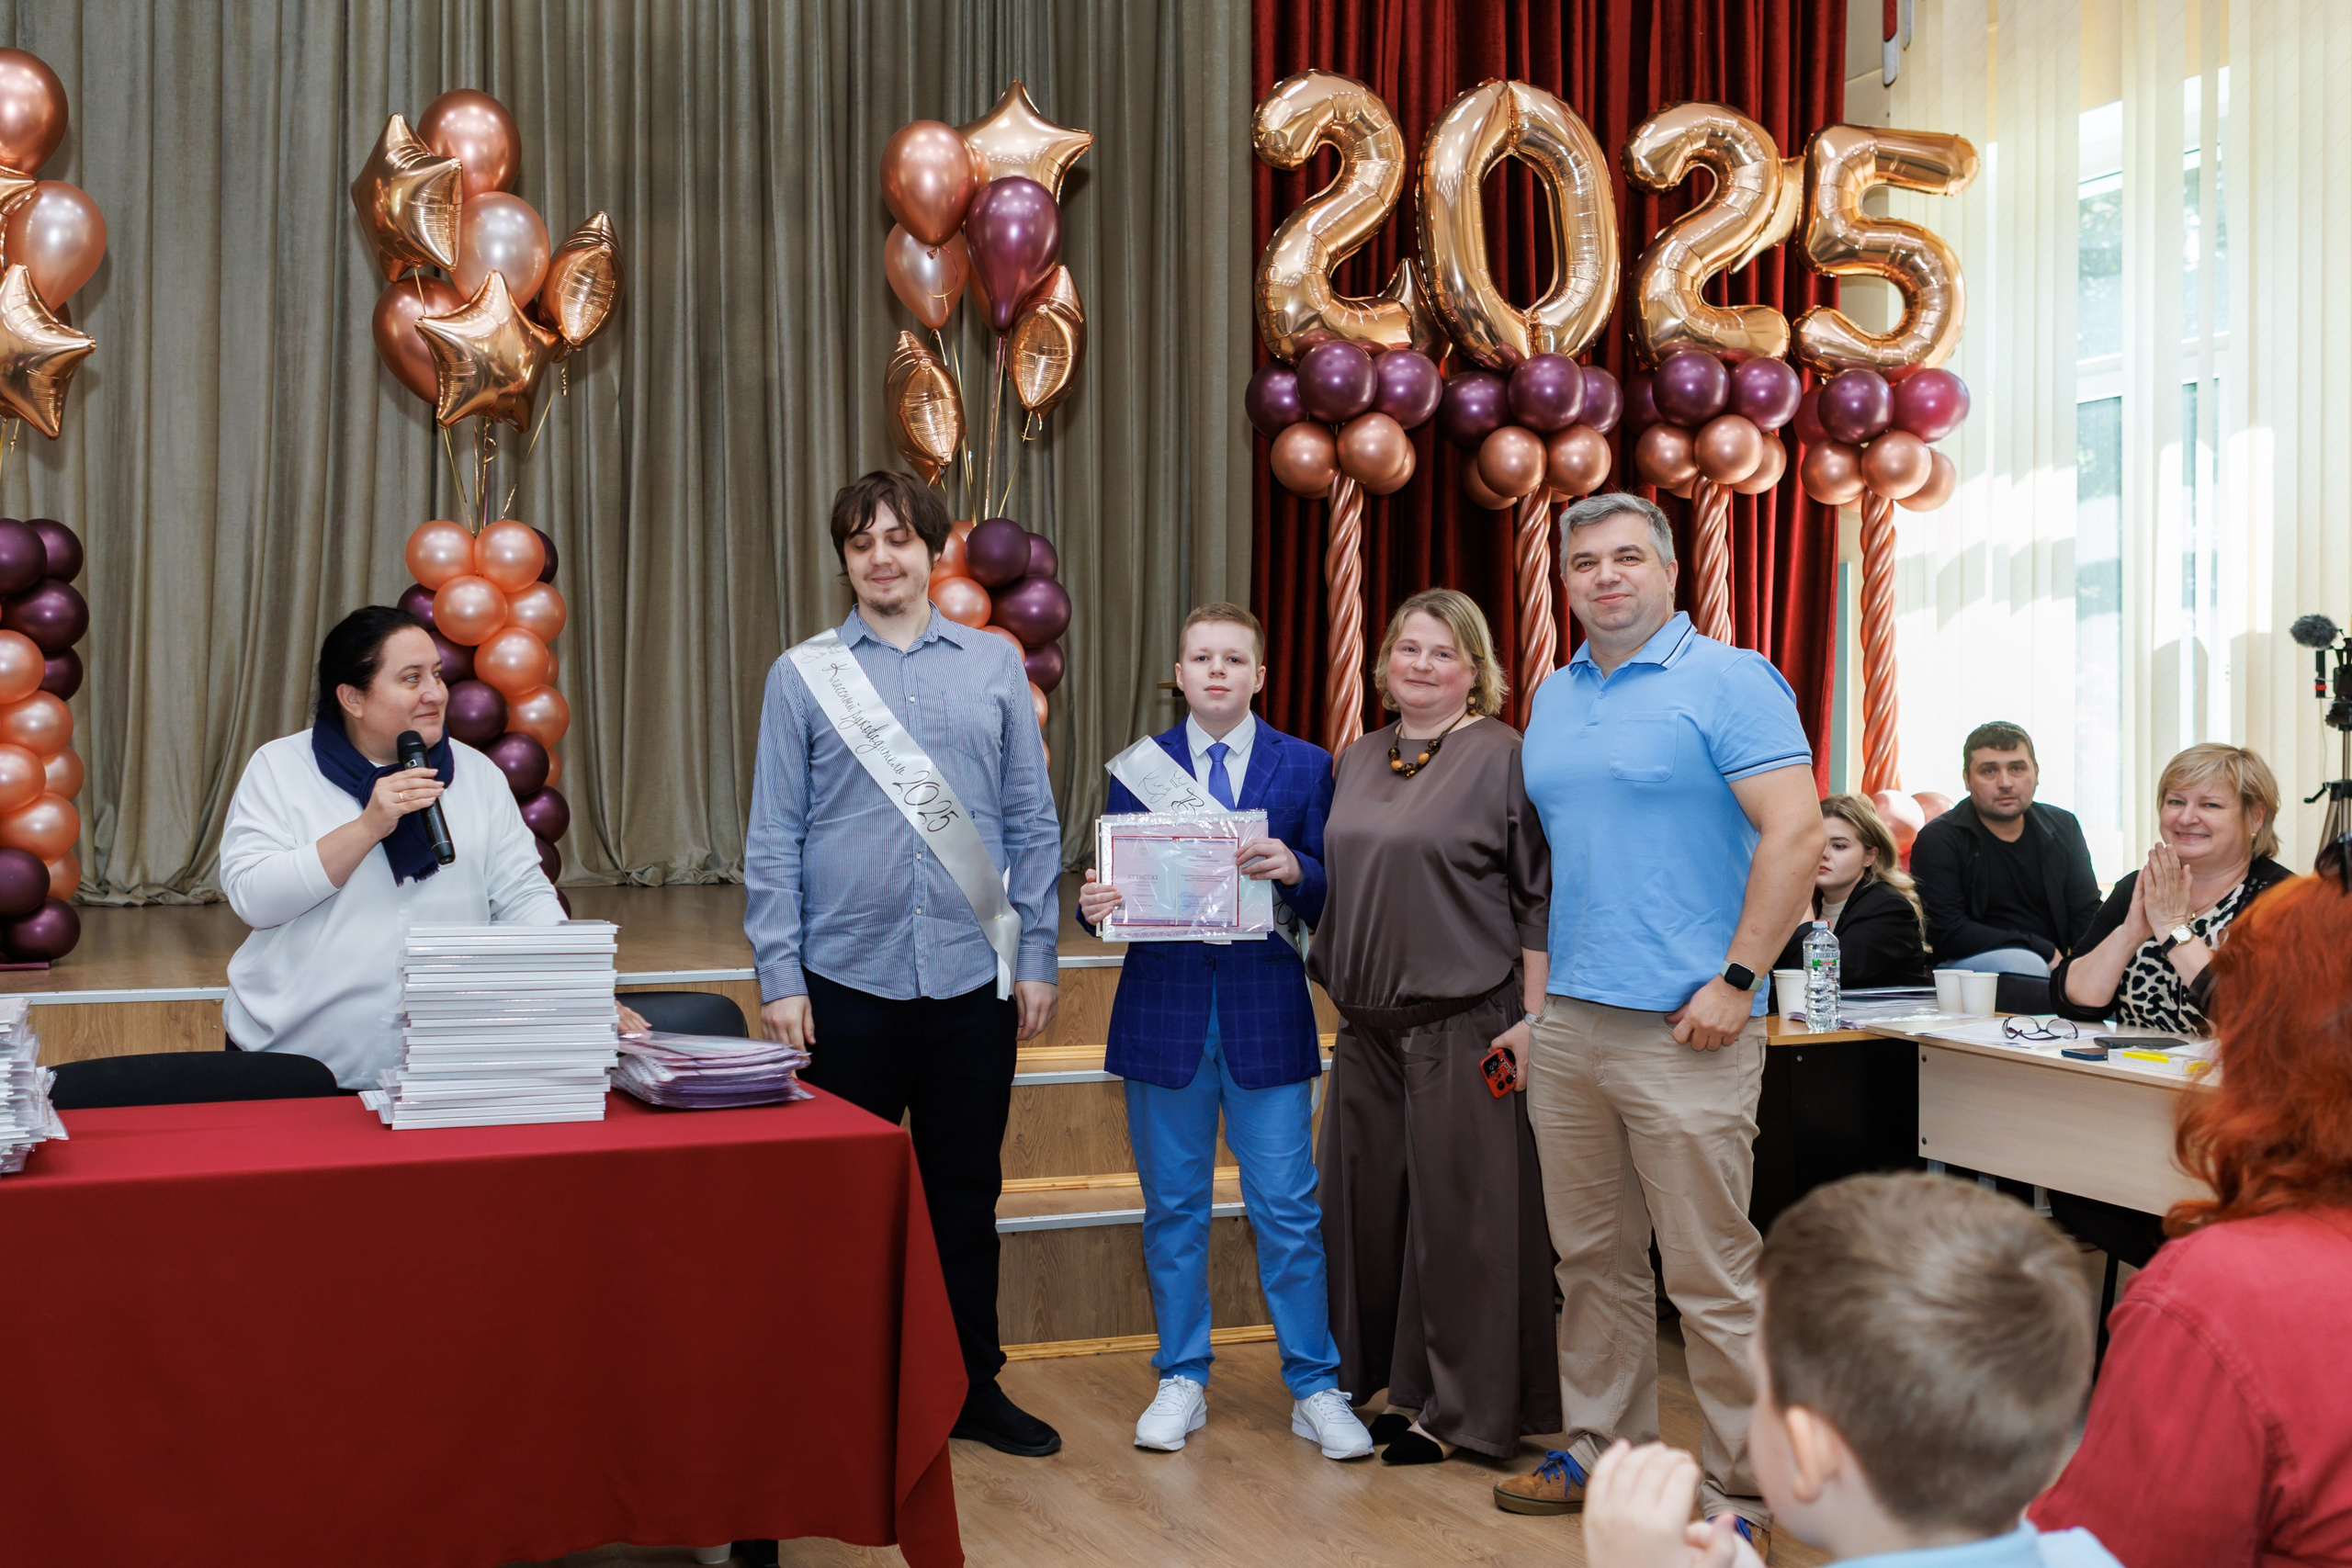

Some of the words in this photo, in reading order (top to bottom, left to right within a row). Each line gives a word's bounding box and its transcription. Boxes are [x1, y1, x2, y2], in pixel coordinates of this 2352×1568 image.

[1250, 68, 1981, 372] 2025
[821, 656, 862, 713] Классный
[838, 707, 905, 776] руководитель
[891, 770, 959, 832] 2025
